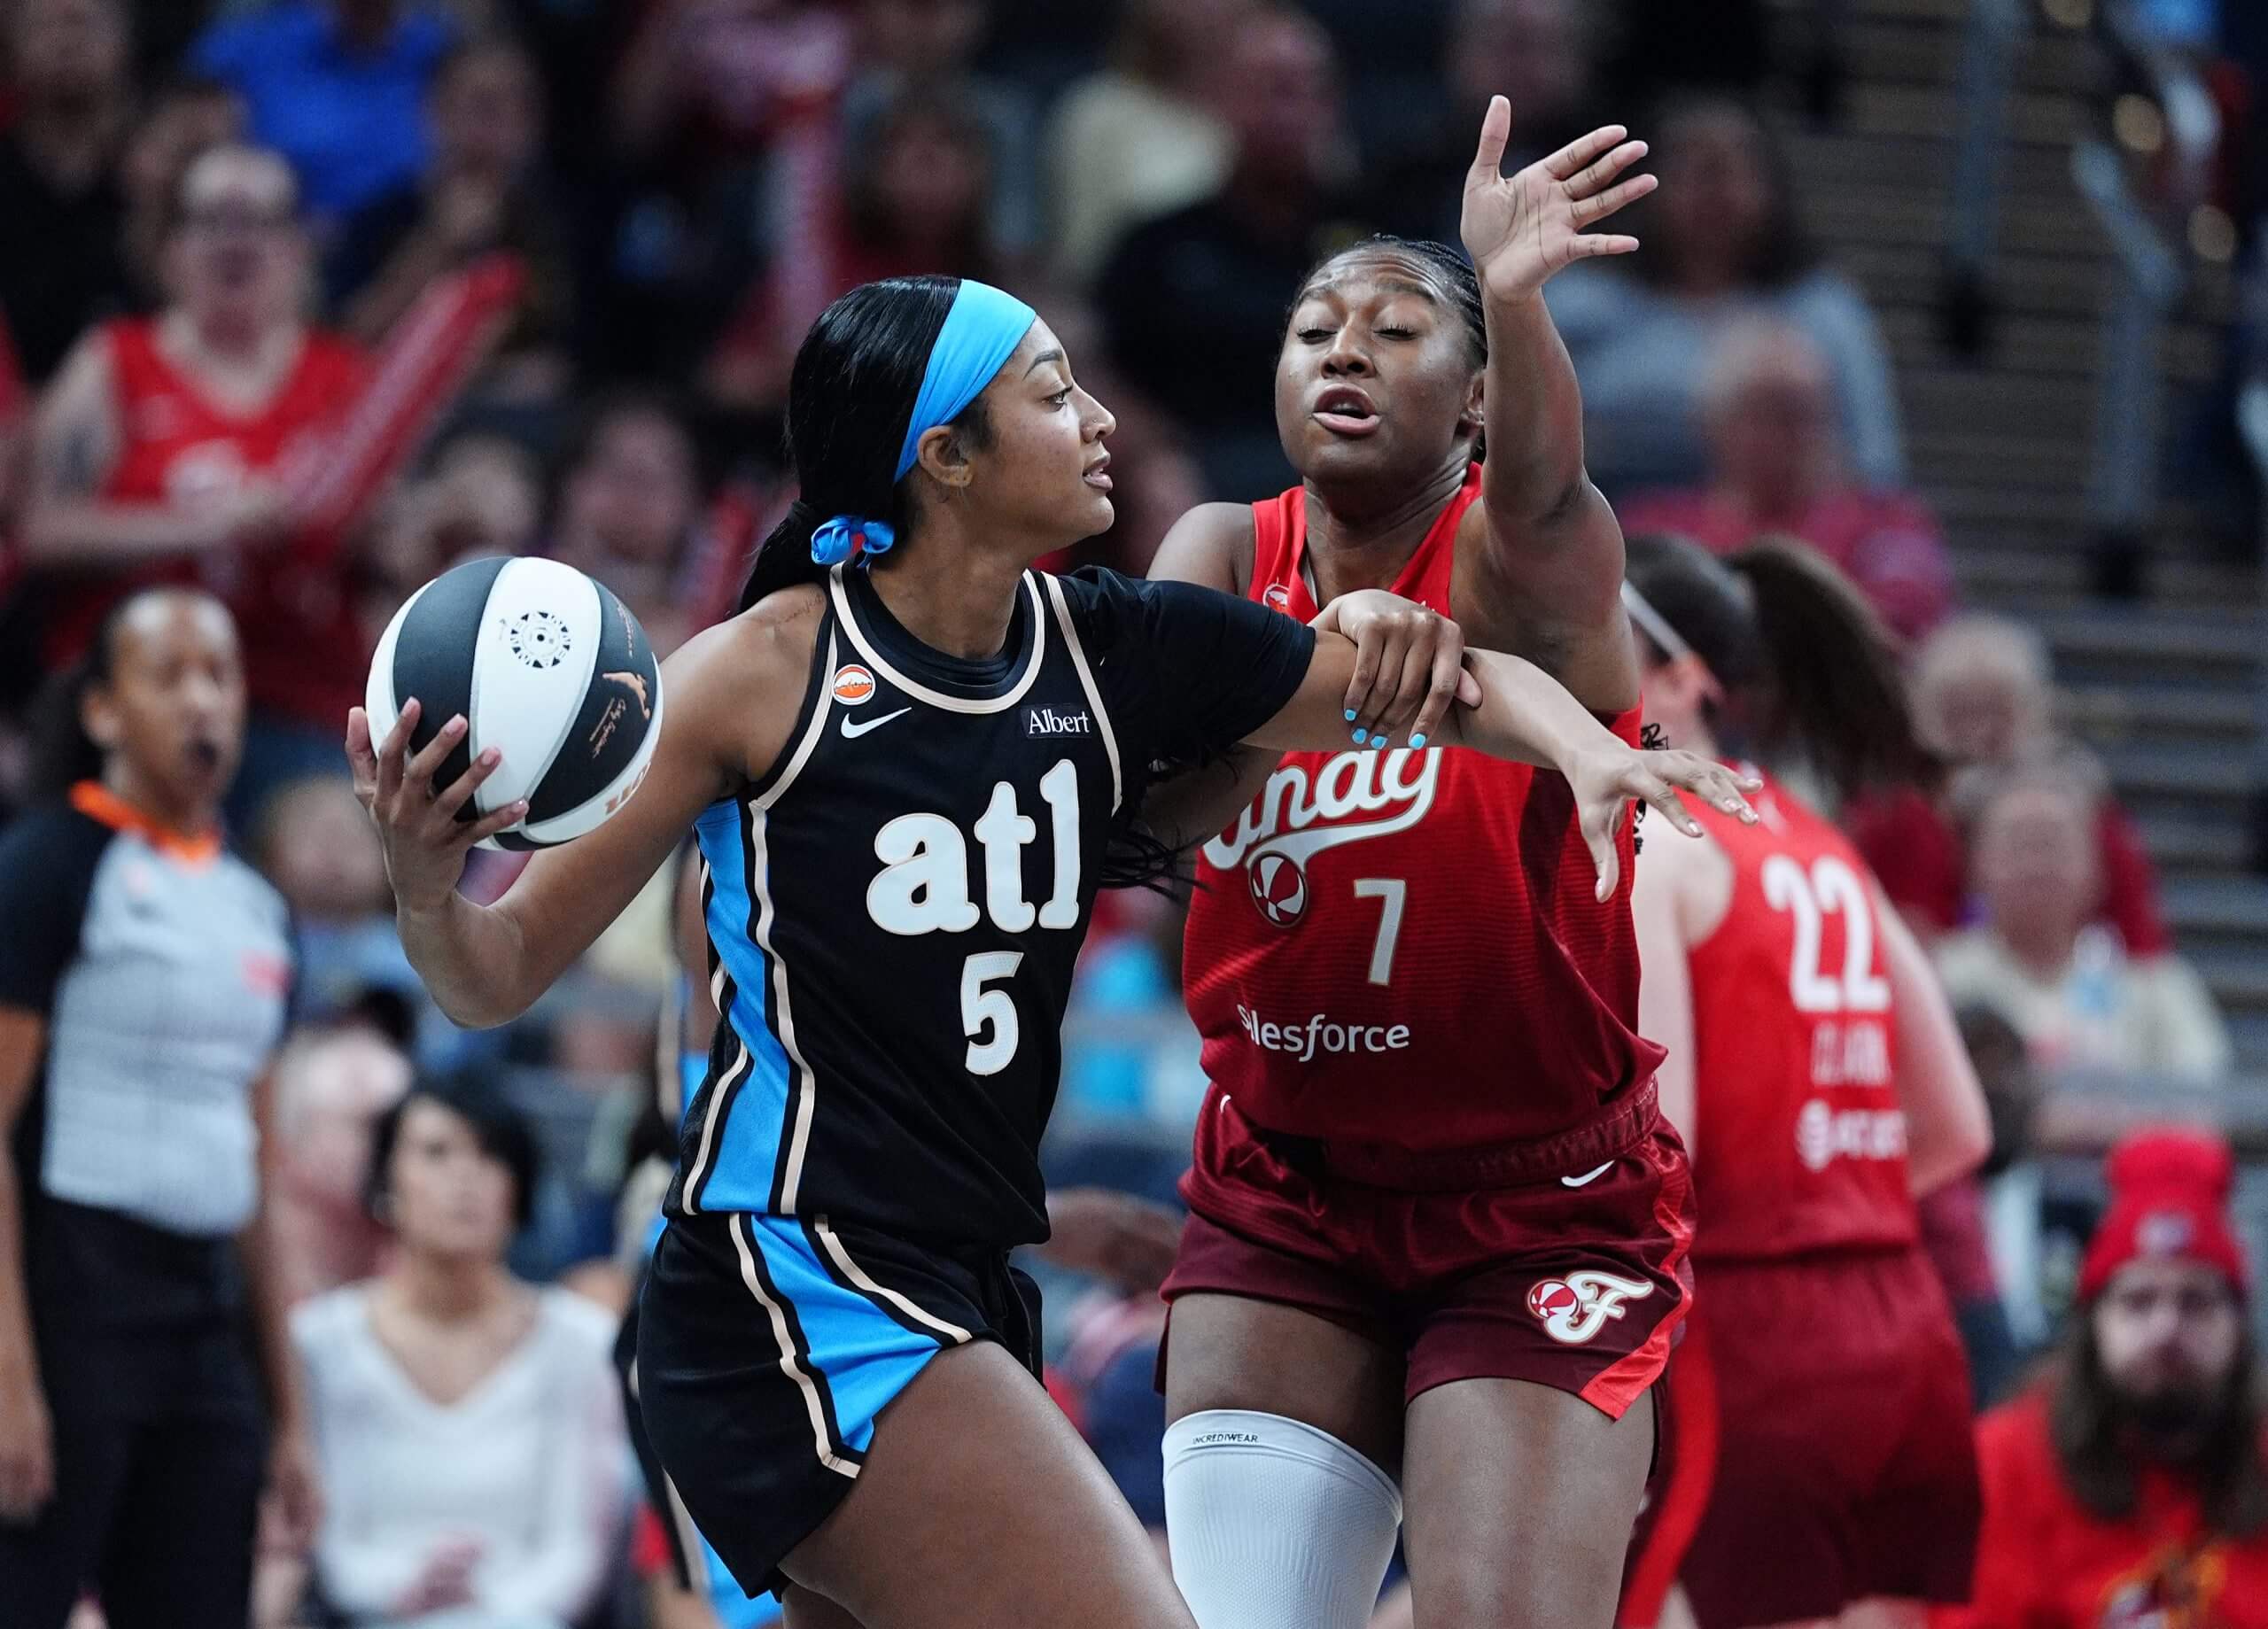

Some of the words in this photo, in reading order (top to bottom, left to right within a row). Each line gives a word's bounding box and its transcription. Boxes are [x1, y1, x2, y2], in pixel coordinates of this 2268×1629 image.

[1029, 708, 1090, 734] Albert
[866, 758, 1081, 935] atl
[1354, 878, 1406, 986] 7
[1761, 853, 1891, 1012] 22
[960, 950, 1024, 1075] 5
[1237, 1004, 1410, 1062] slesforce
[1192, 1432, 1259, 1445] INCREDIWEAR
